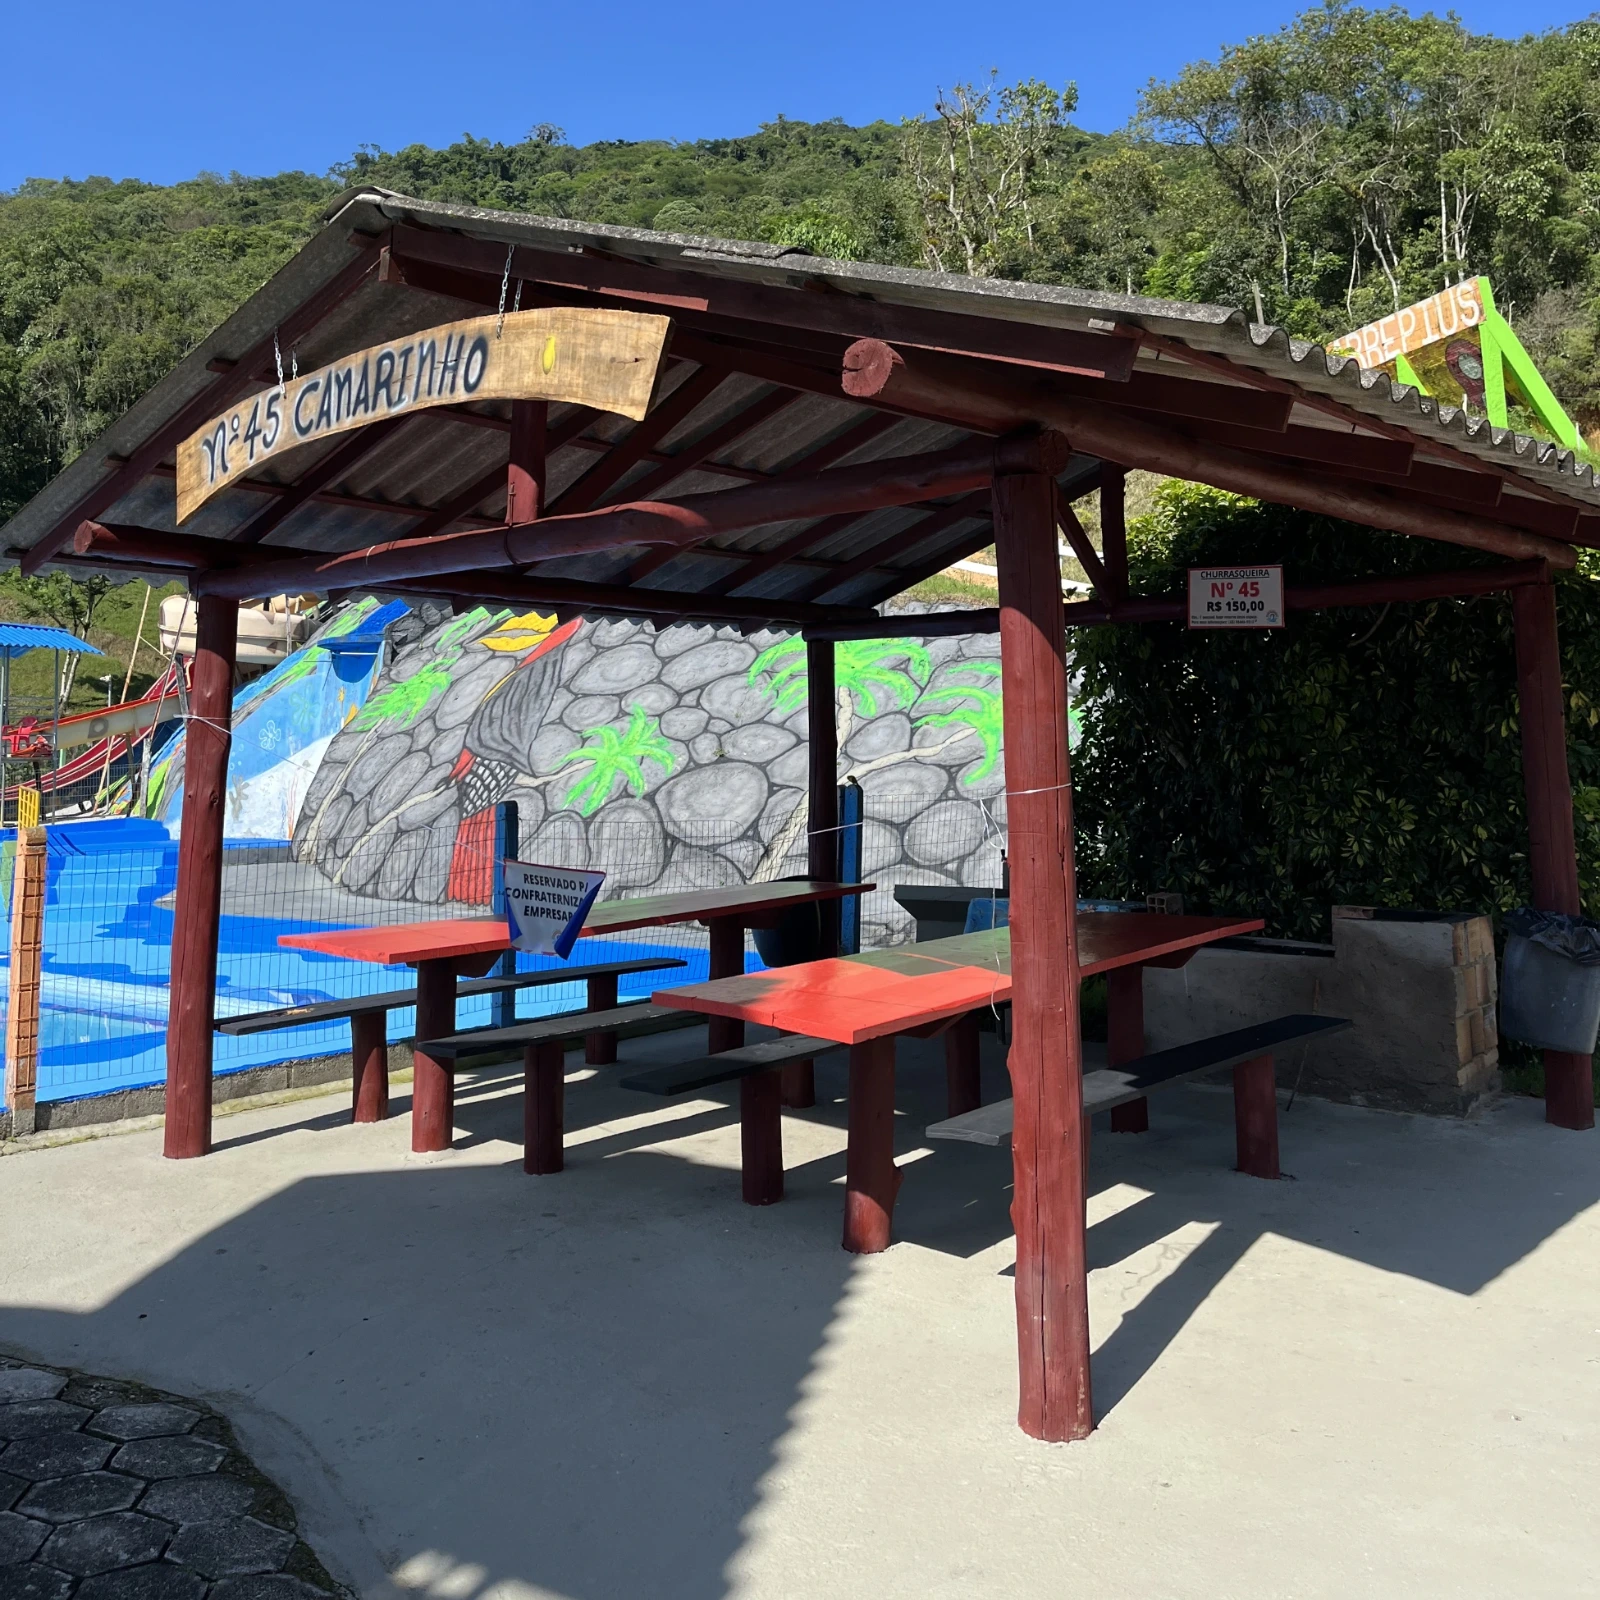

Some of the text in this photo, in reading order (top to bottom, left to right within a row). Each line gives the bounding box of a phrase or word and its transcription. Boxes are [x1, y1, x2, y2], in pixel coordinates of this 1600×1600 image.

[1334, 282, 1480, 369] RREPIUS
[244, 392, 281, 461] 45
[1200, 569, 1270, 579] CHURRASQUEIRA
[1238, 581, 1260, 597] 45
[1206, 601, 1264, 613] R$ 150,00
[523, 873, 577, 891] RESERVADO
